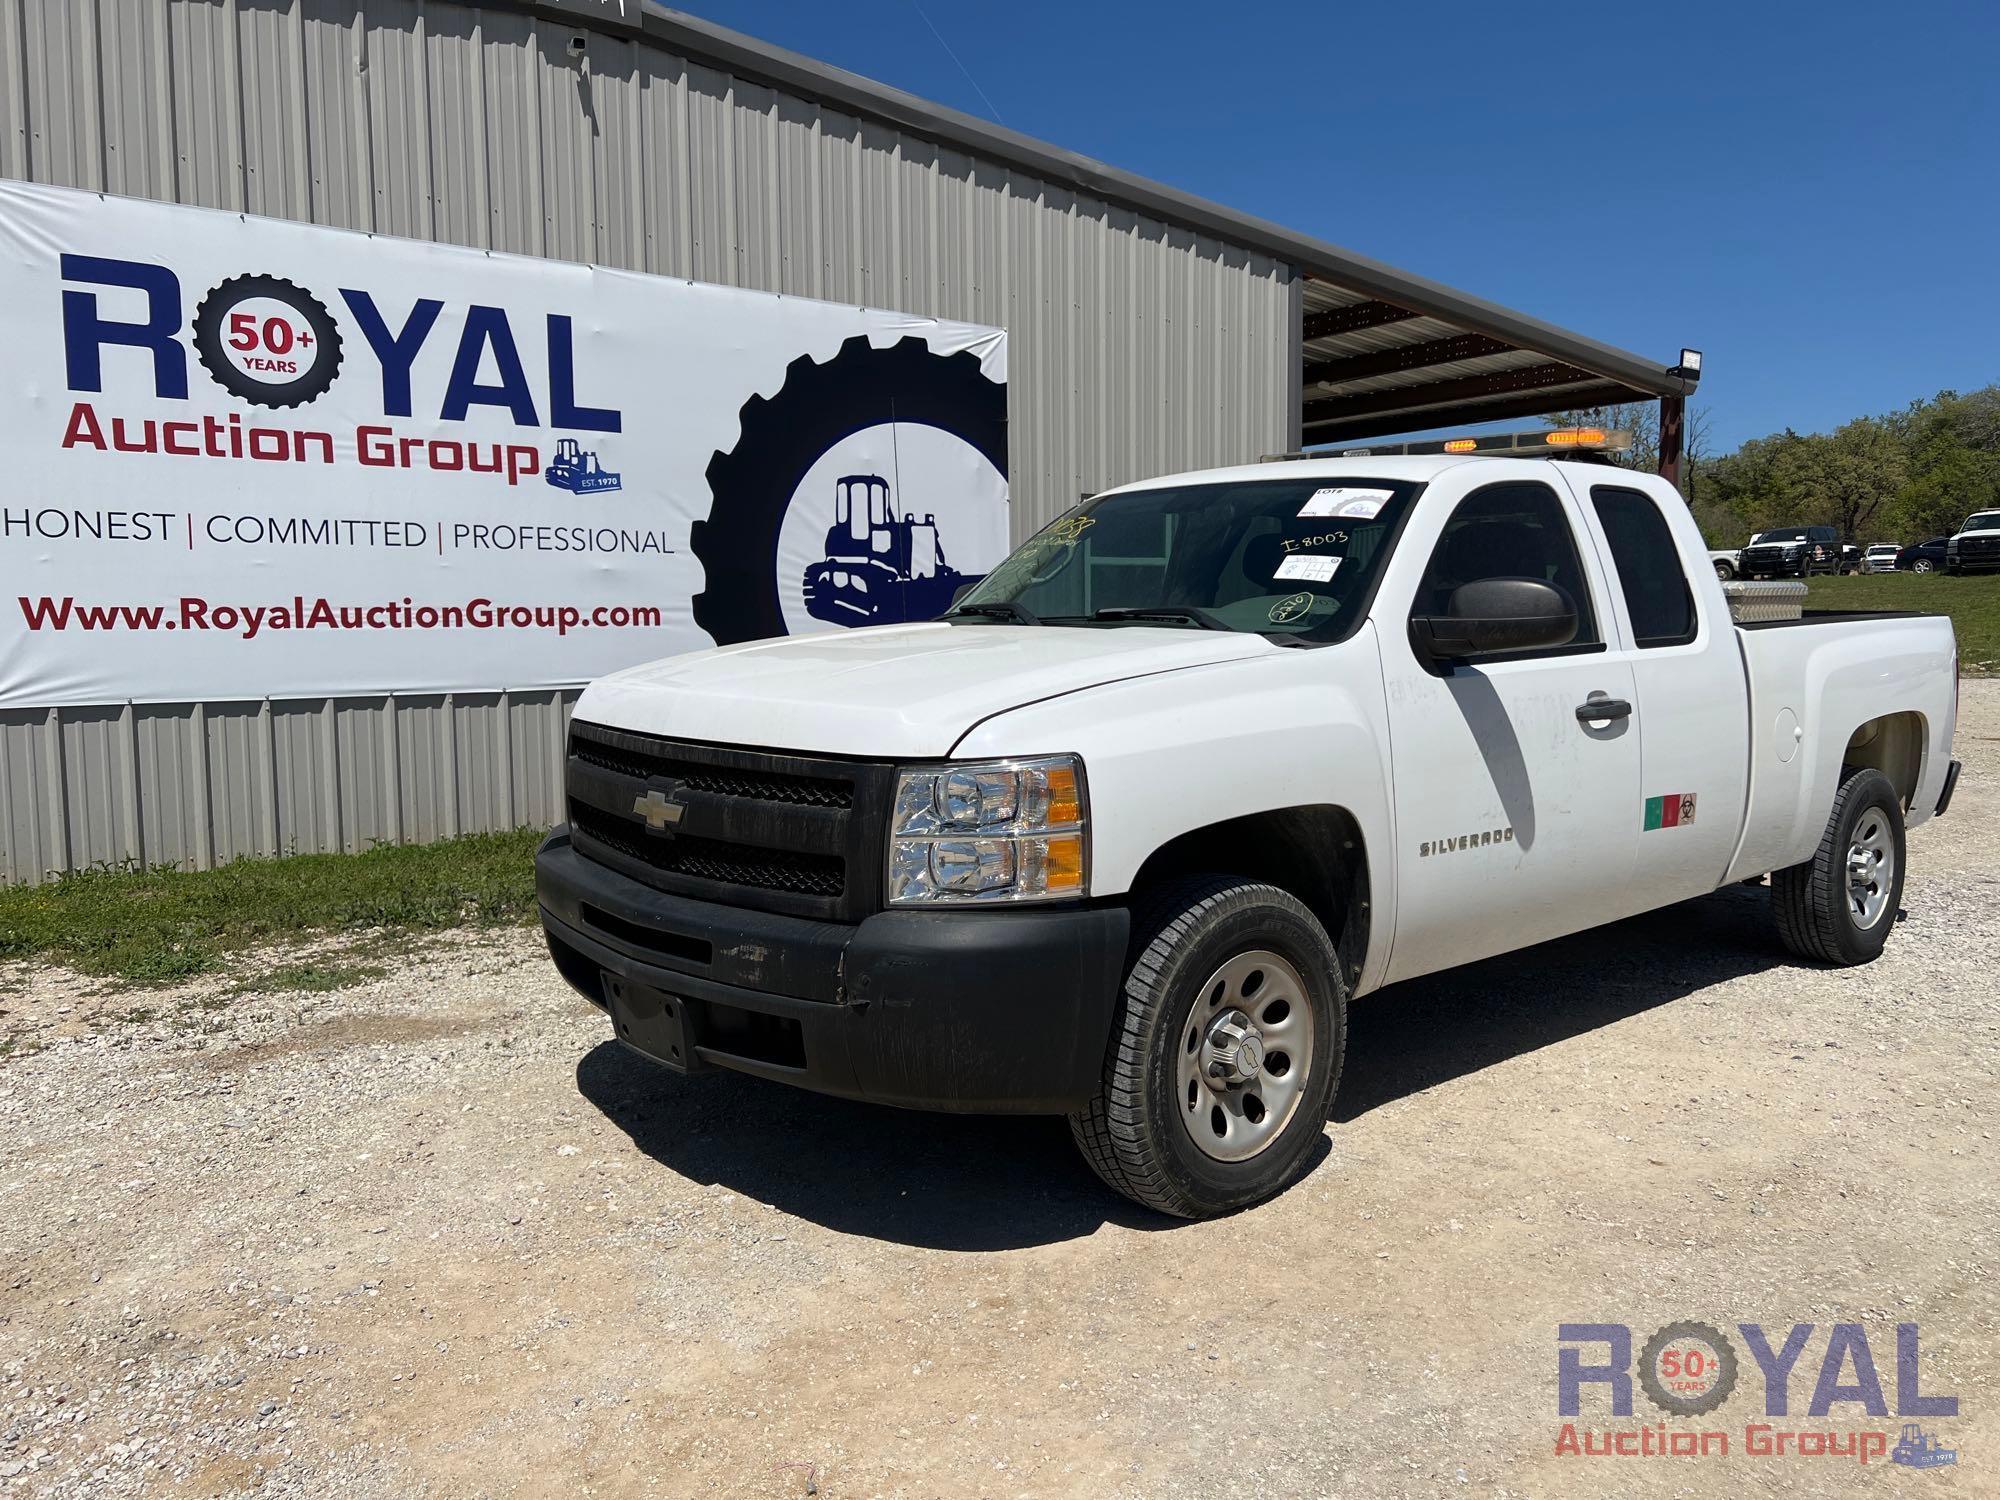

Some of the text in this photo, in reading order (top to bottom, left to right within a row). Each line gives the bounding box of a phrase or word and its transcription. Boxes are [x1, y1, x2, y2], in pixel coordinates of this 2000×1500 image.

[61, 253, 622, 433] ROYAL
[228, 313, 313, 355] 50+
[243, 356, 297, 374] YEARS
[62, 403, 540, 485] Auction Group
[598, 478, 618, 486] 1970
[3, 508, 675, 554] HONEST COMMITTED PROFESSIONAL
[18, 597, 661, 640] Www.RoyalAuctionGroup.com
[1419, 827, 1514, 857] SILVERADO
